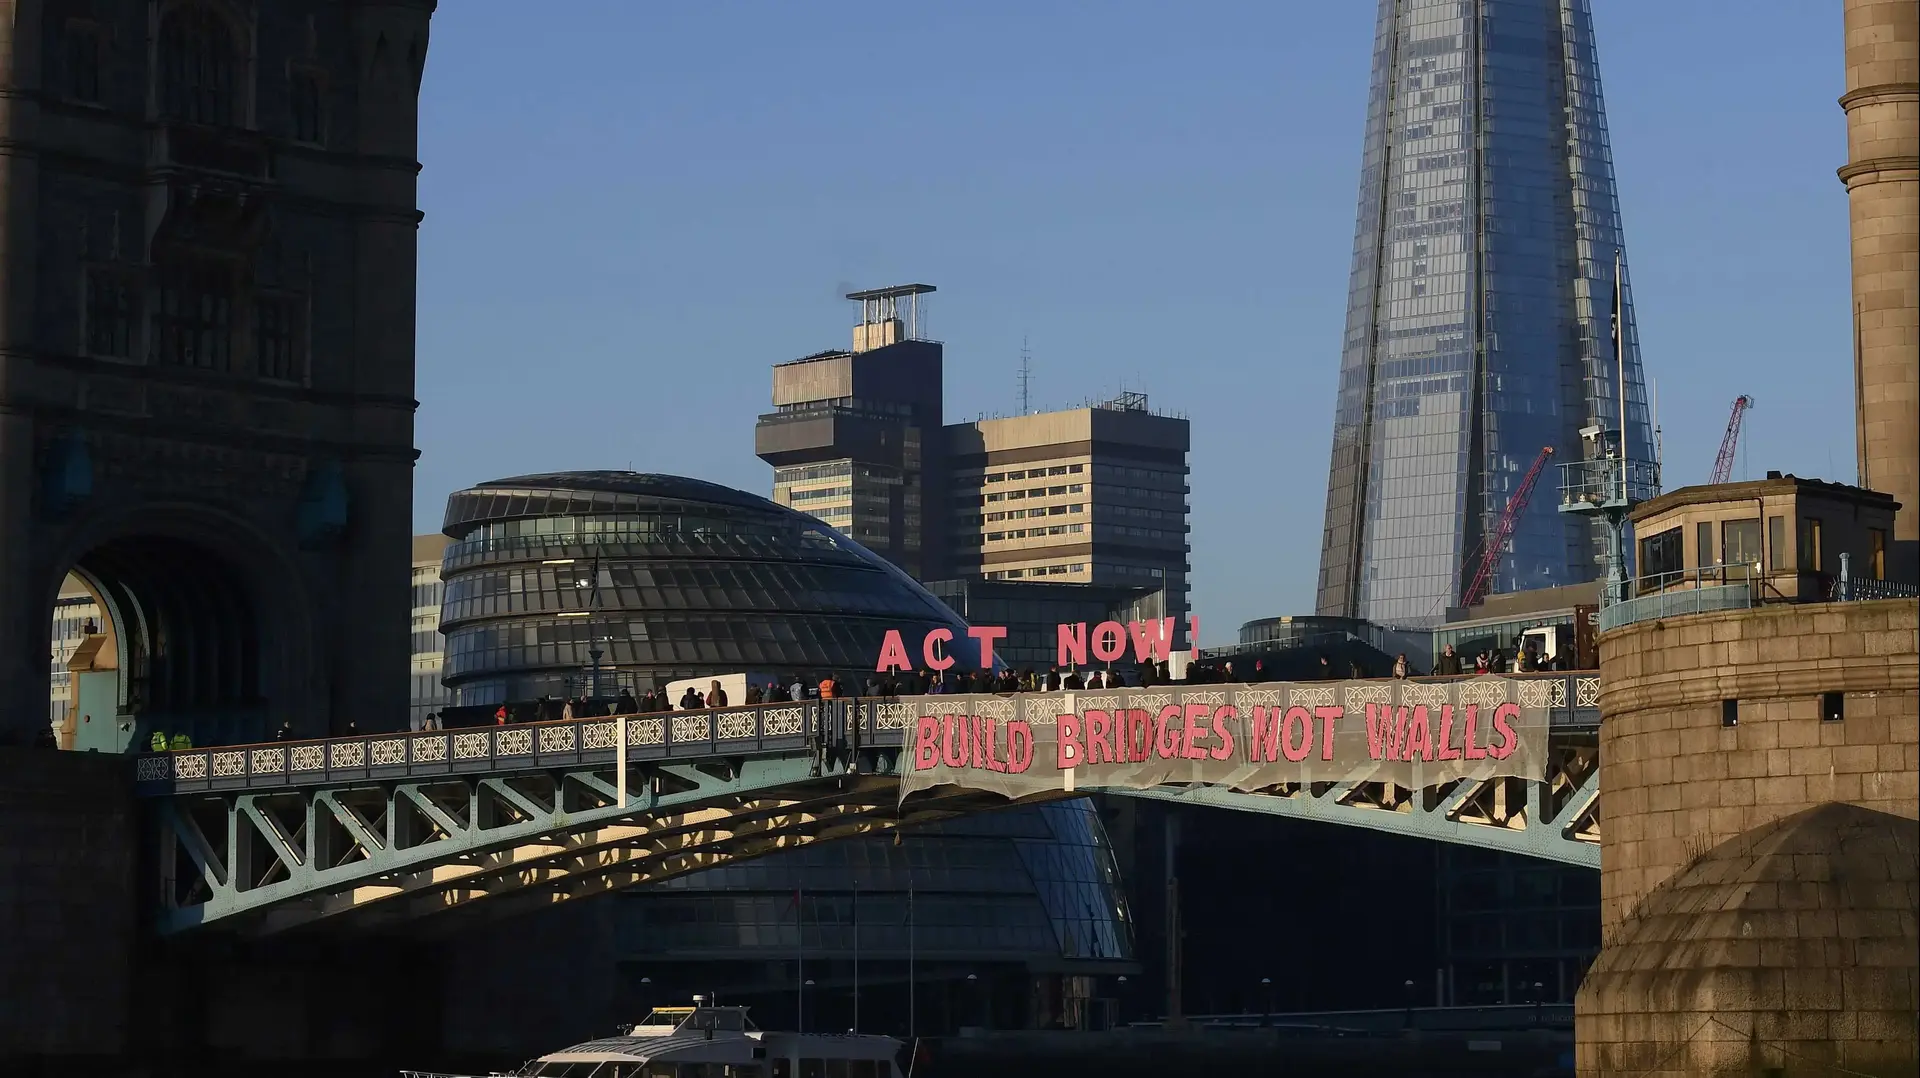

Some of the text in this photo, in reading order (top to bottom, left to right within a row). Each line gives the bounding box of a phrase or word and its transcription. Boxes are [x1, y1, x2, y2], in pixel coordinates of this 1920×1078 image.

[876, 616, 1199, 672] ACT NOW!
[915, 702, 1521, 774] BUILD BRIDGES NOT WALLS
